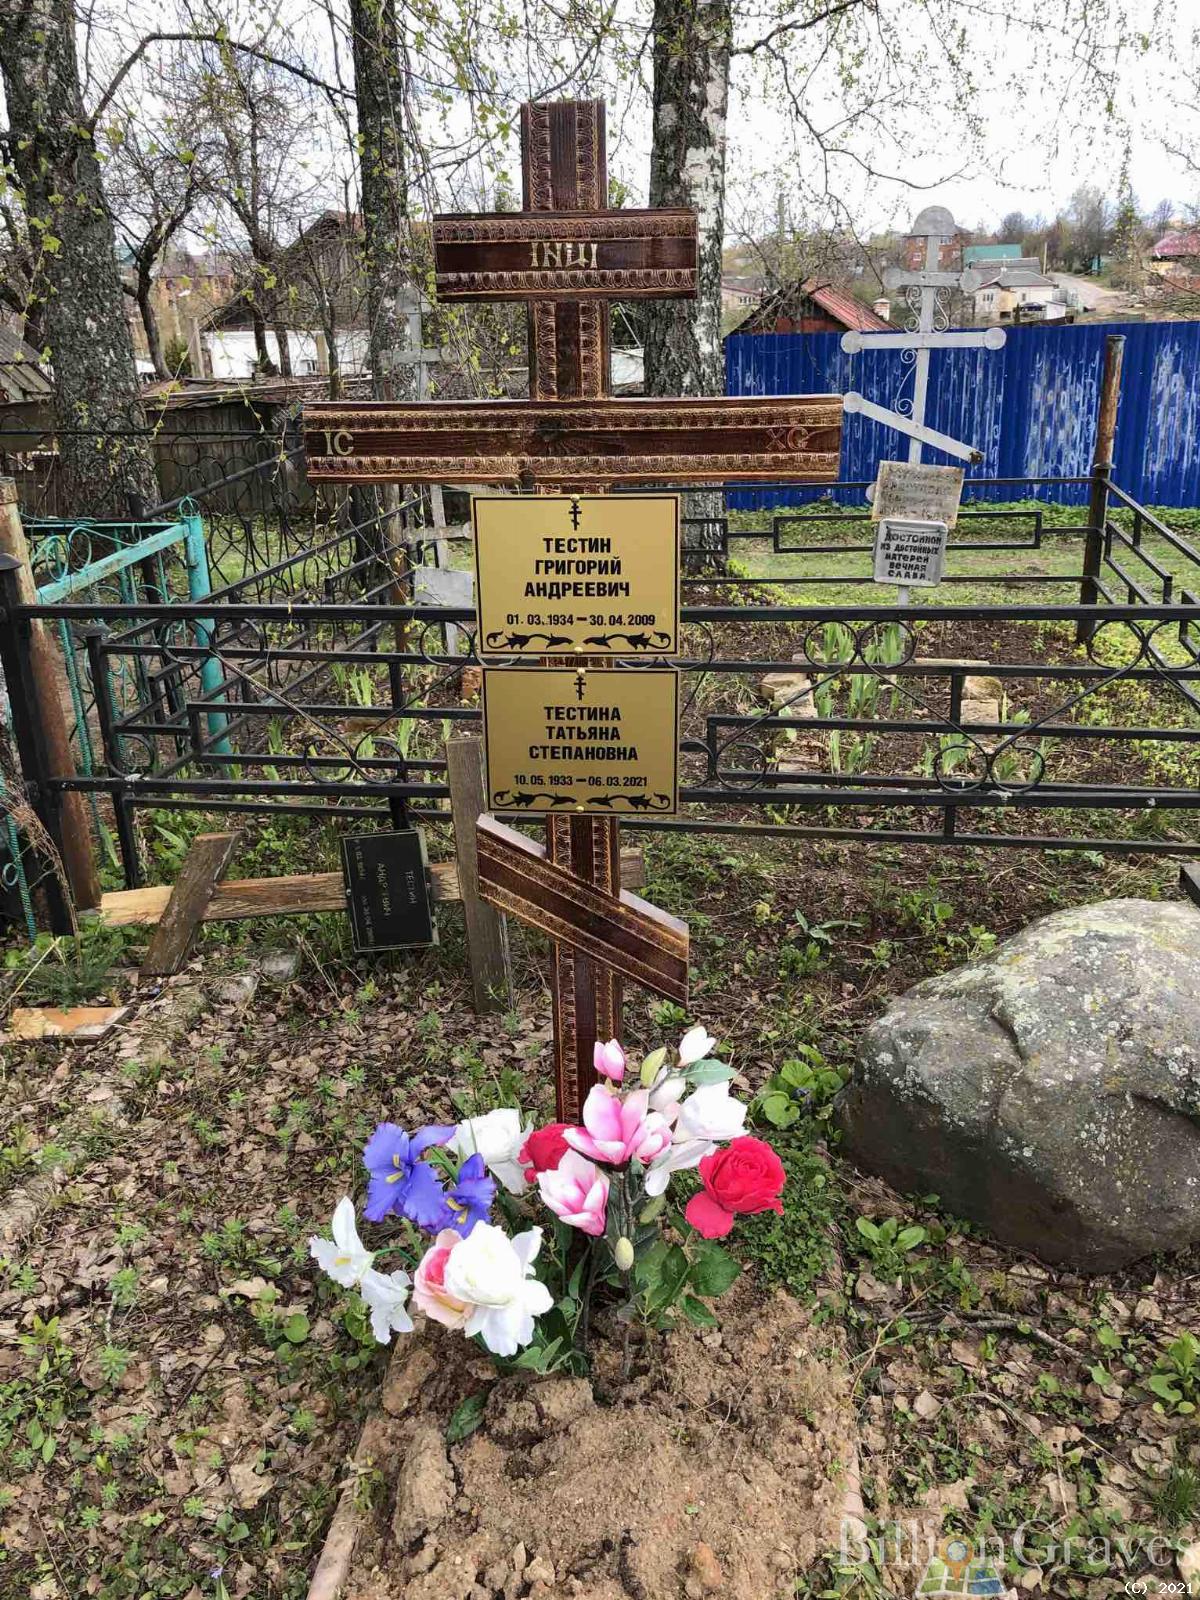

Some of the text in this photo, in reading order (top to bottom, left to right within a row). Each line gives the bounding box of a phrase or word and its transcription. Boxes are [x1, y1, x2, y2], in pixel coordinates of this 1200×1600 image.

[543, 537, 611, 553] ТЕСТИН
[880, 542, 891, 551] ИЗ
[535, 556, 621, 575] ГРИГОРИЙ
[524, 582, 630, 599] АНДРЕЕВИЧ
[544, 706, 621, 721] ТЕСТИНА
[545, 726, 621, 740] ТАТЬЯНА
[528, 745, 639, 761] СТЕПАНОВНА
